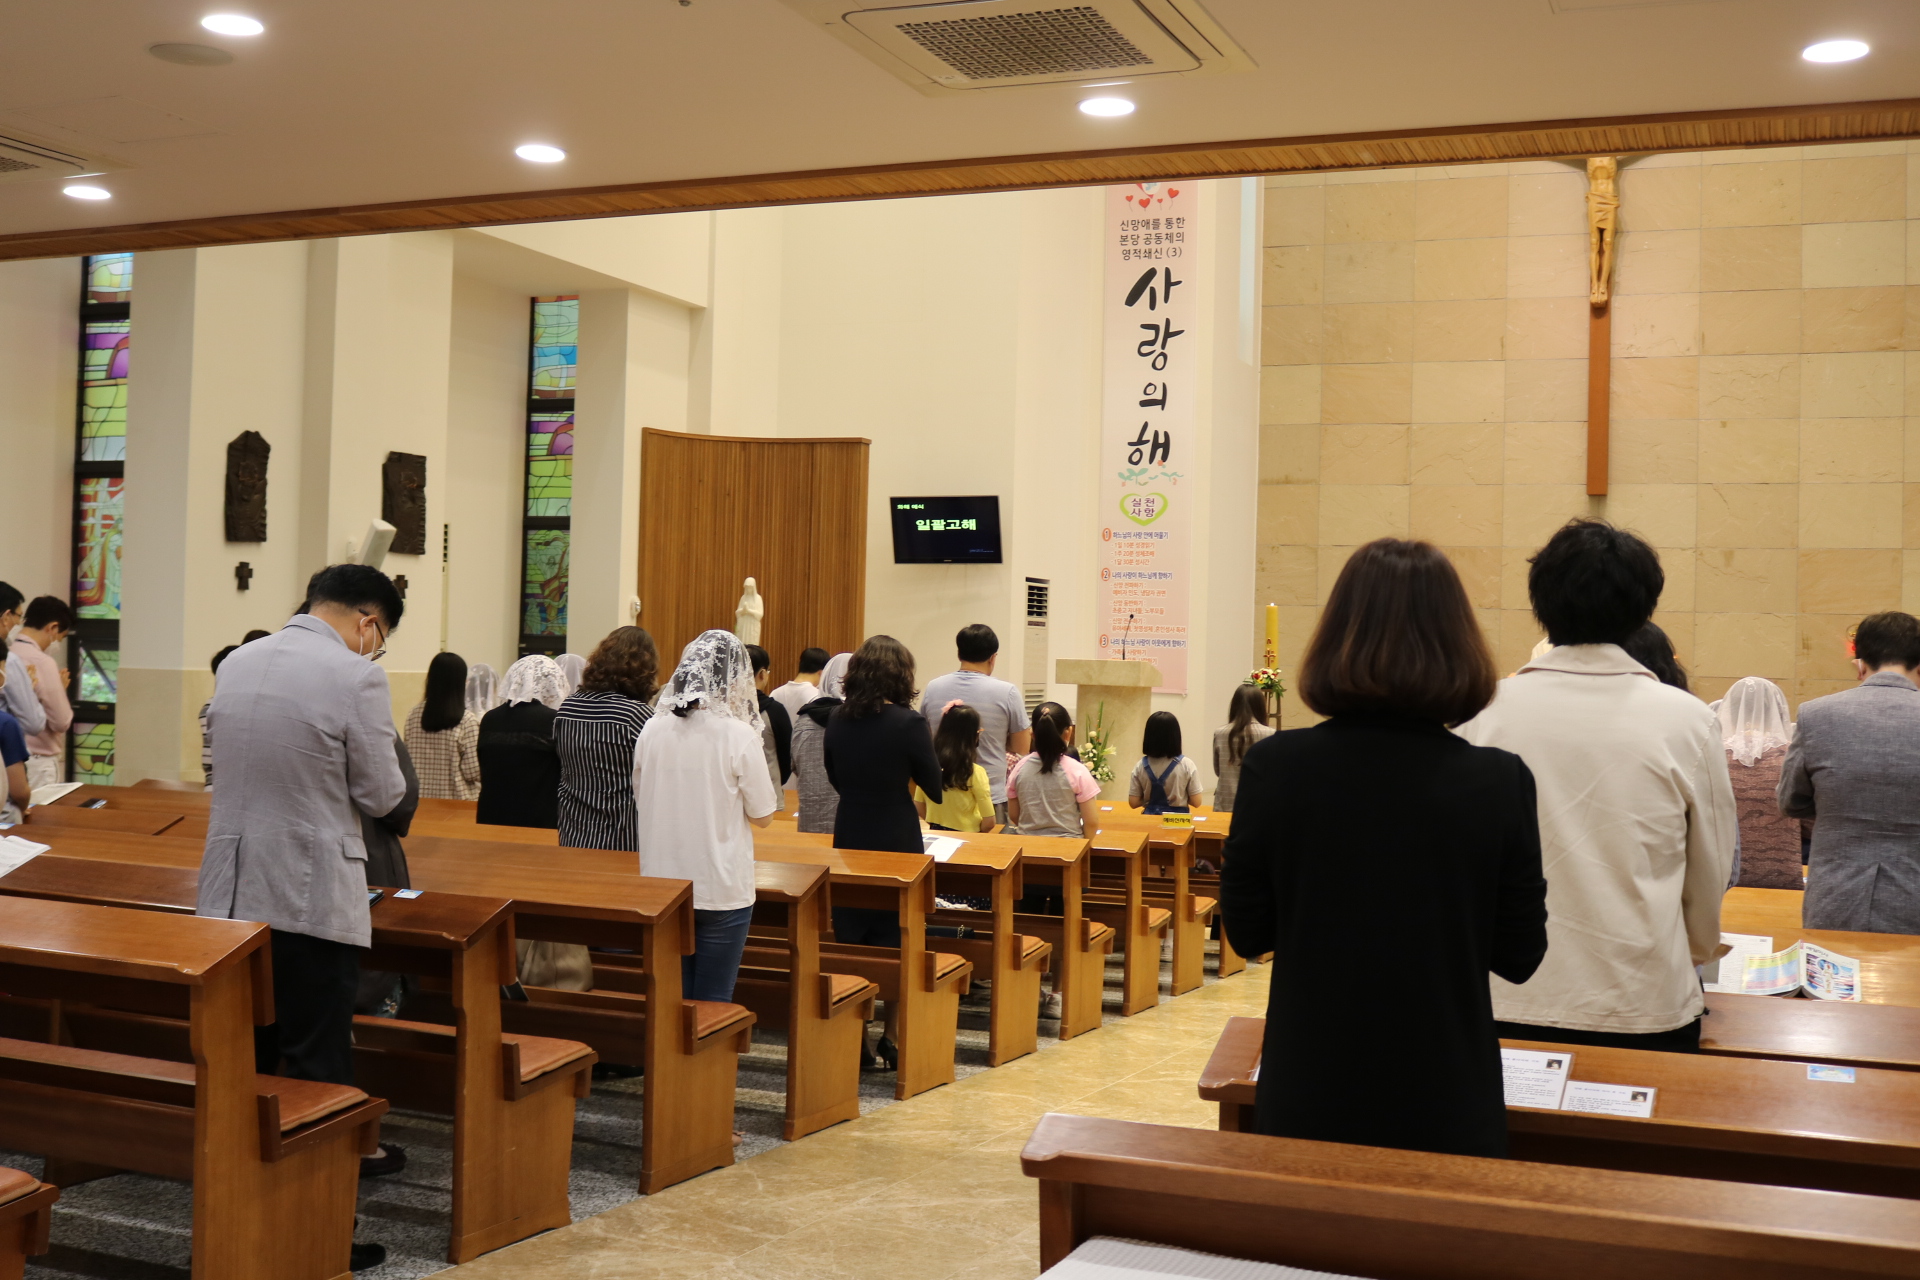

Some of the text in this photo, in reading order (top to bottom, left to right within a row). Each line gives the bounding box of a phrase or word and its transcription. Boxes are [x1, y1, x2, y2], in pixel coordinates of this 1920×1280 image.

[1120, 217, 1186, 232] 신망애를 통한
[1119, 232, 1184, 246] 본당 공동체의
[1122, 246, 1183, 261] 영적쇄신 (3)
[1131, 498, 1155, 507] 실천
[1130, 508, 1155, 517] 사항
[915, 519, 977, 531] 일괄고해
